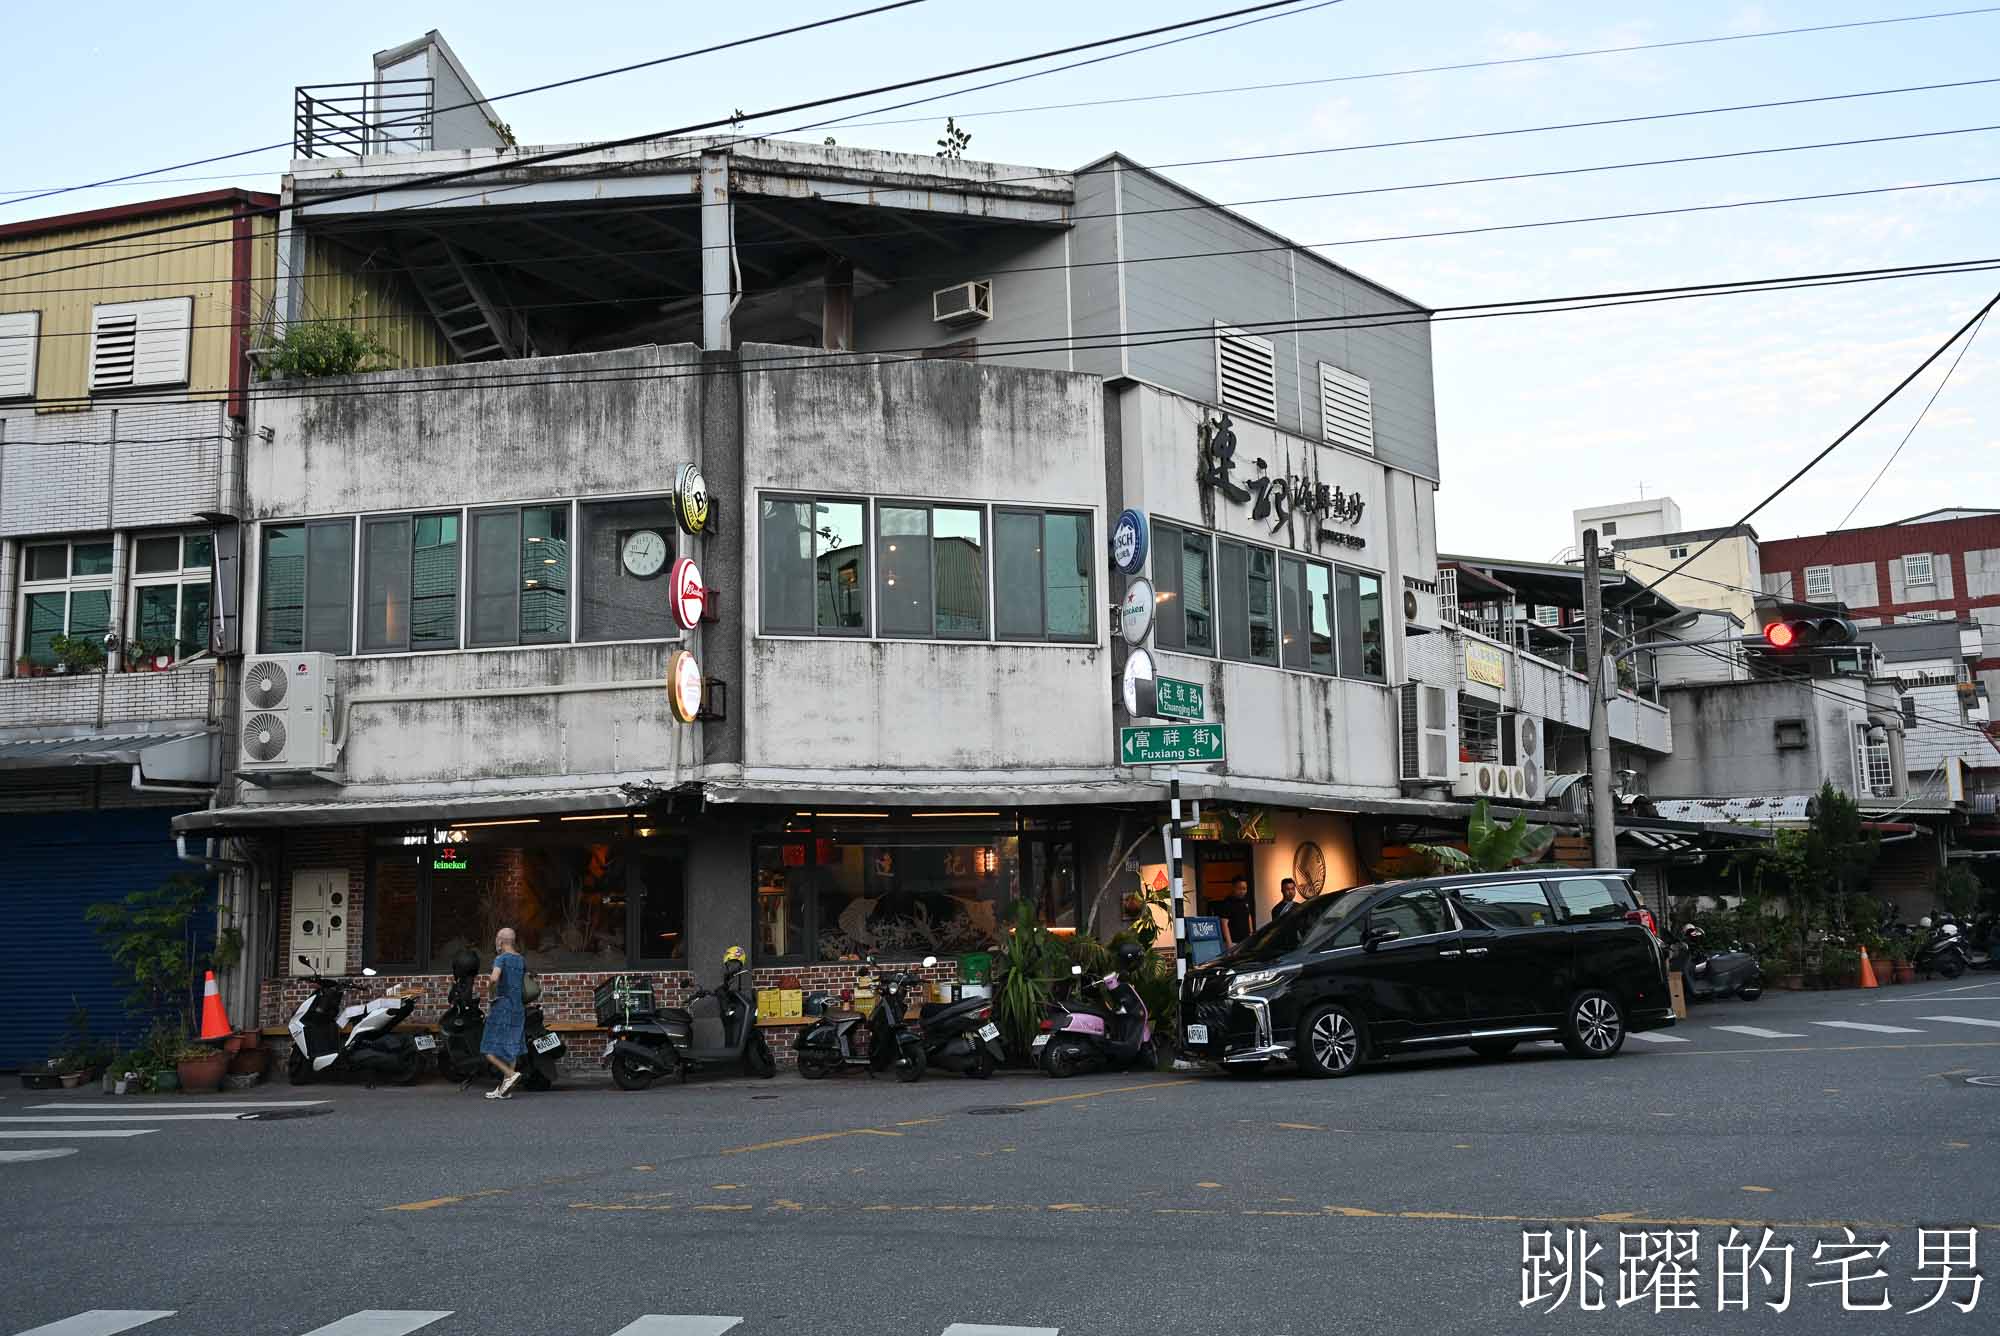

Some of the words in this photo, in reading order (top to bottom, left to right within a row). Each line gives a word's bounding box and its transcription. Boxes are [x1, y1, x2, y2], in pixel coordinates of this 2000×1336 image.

[1163, 682, 1198, 704] 莊敬路
[1134, 729, 1209, 748] 富祥街
[1141, 748, 1185, 760] Fuxiang
[1188, 747, 1203, 758] St.
